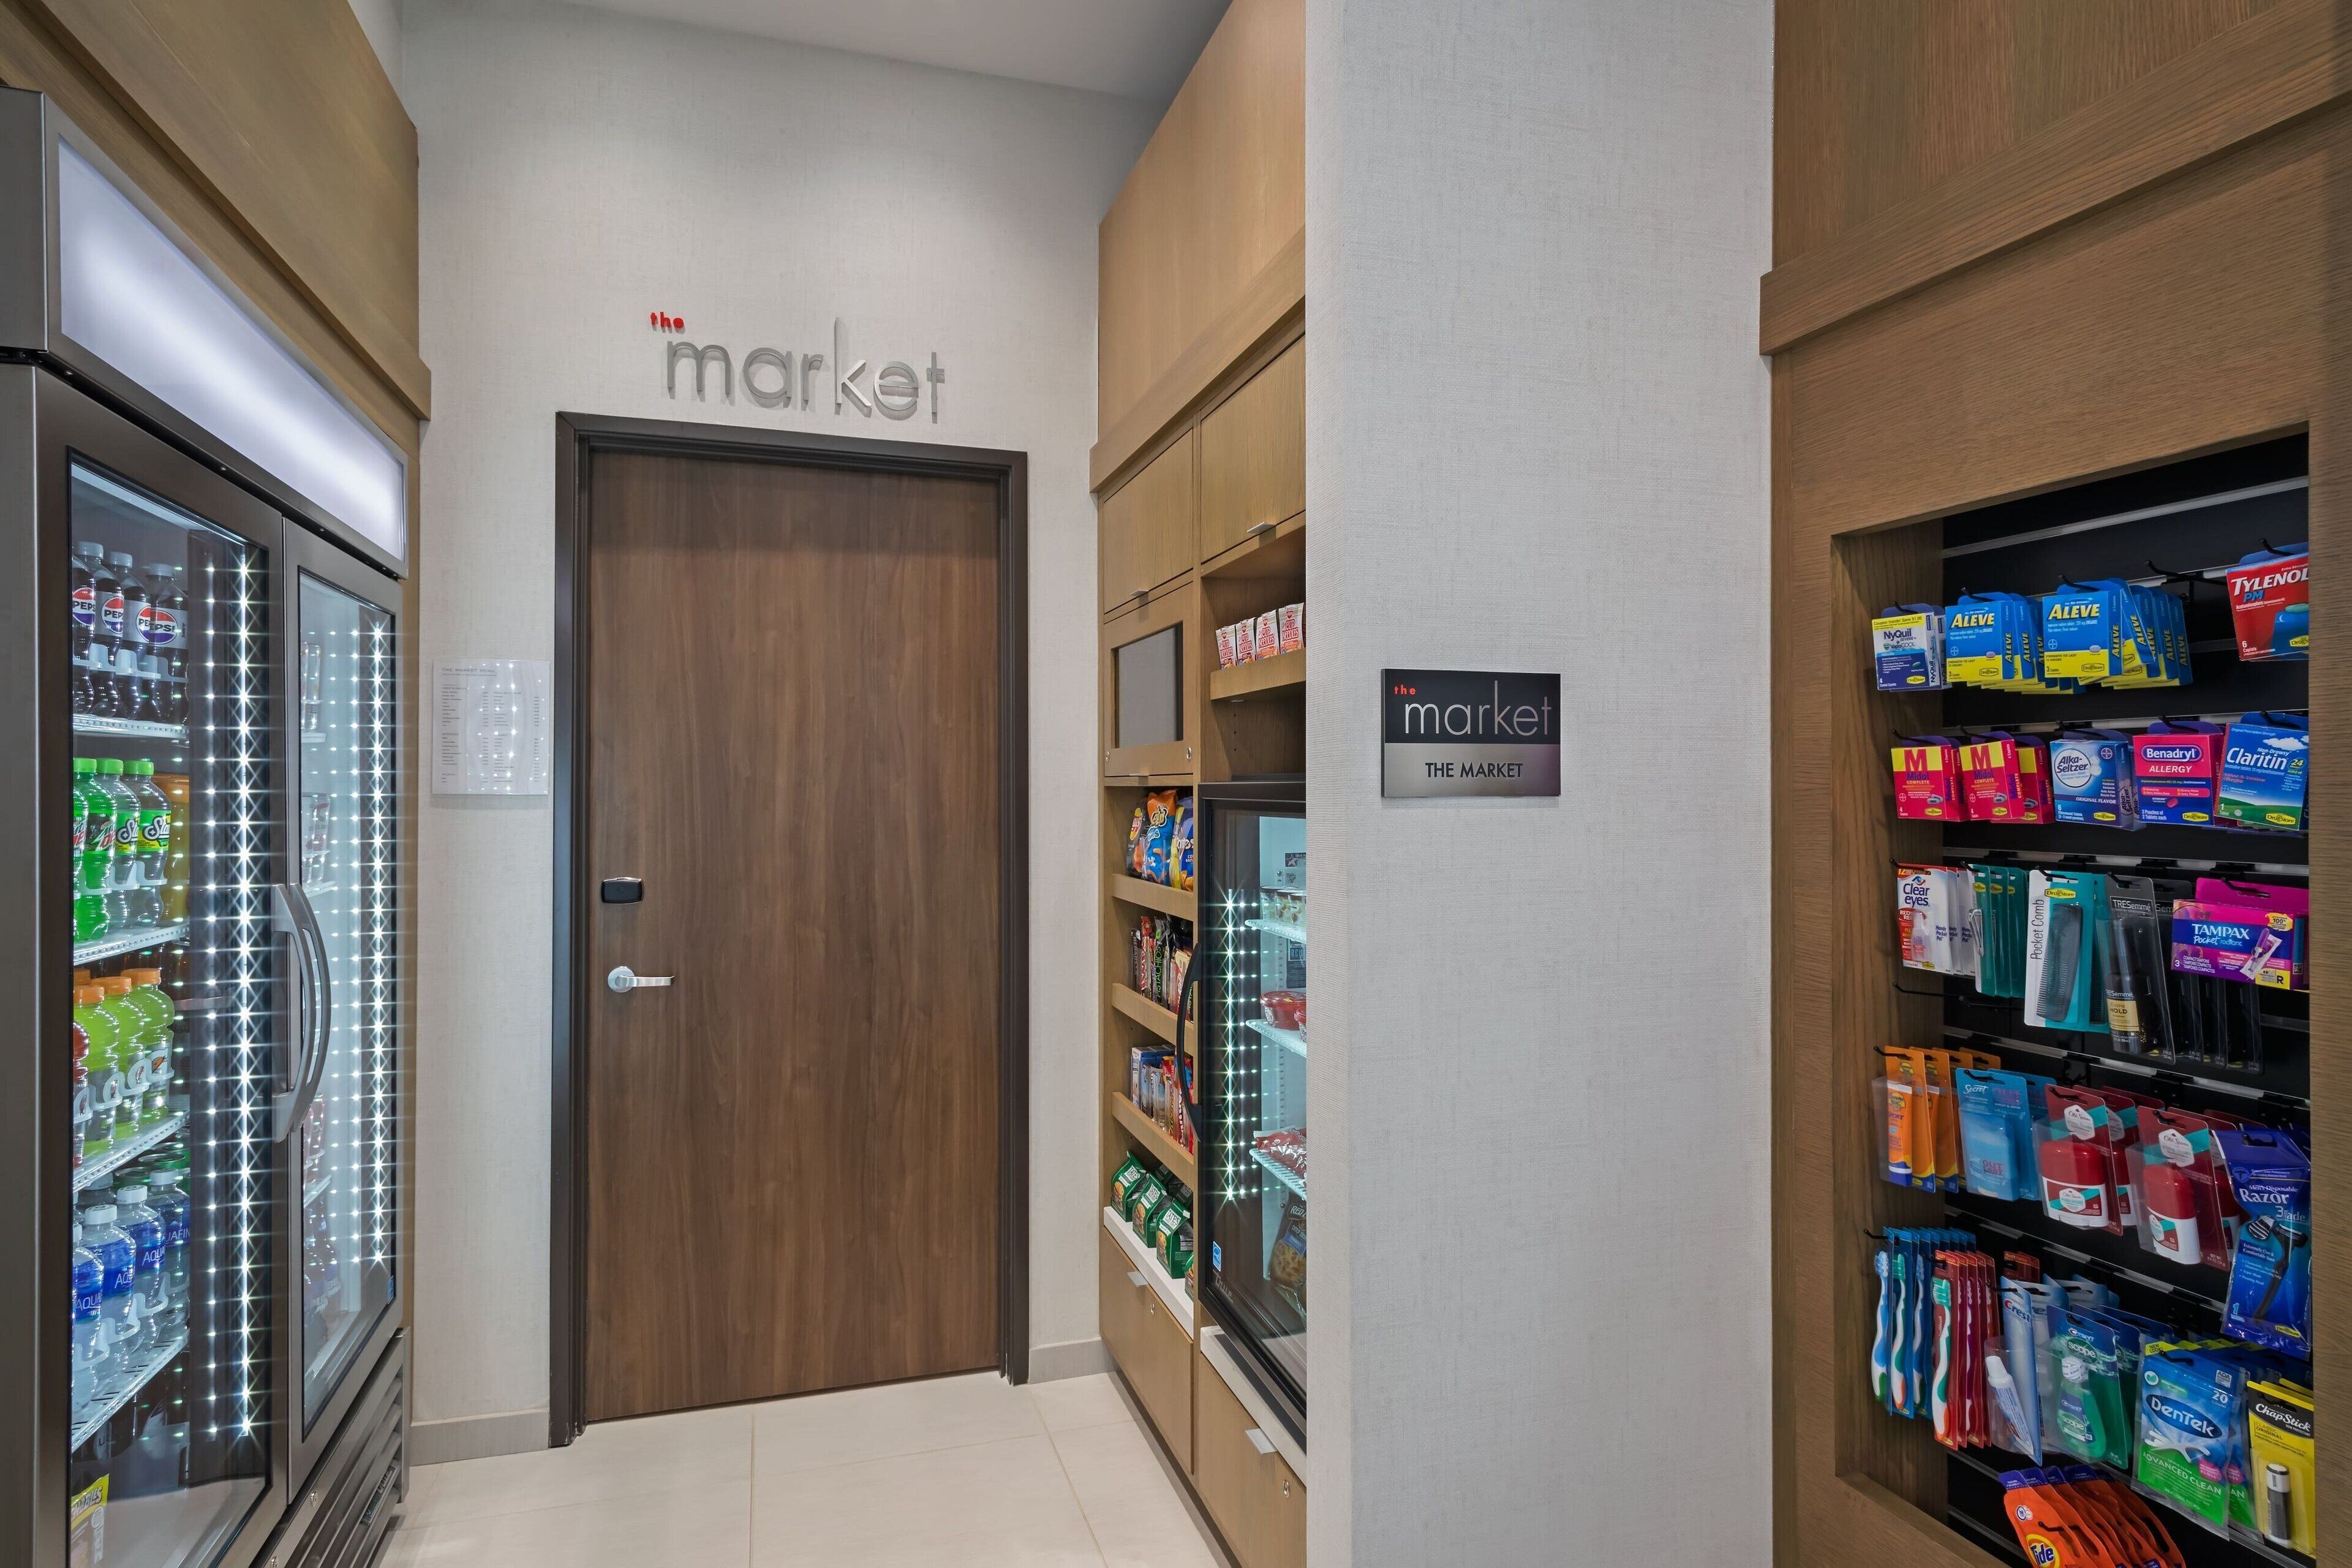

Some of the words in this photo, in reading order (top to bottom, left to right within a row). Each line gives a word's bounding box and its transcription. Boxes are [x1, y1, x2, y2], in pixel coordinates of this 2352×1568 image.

[650, 312, 684, 328] the
[667, 317, 945, 414] market
[2231, 568, 2309, 596] TYLENOL
[2244, 590, 2263, 602] PM
[2048, 603, 2100, 620] ALEVE
[1951, 613, 1995, 629] ALEVE
[1883, 628, 1912, 641] NyQuil
[2130, 615, 2146, 646] ALEVE
[2164, 629, 2174, 661] ALEVE
[2178, 635, 2188, 666] ALEVE
[1394, 684, 1416, 695] the
[1405, 680, 1552, 736] market
[1904, 748, 1928, 771] M
[1970, 745, 1992, 770] M
[2147, 748, 2196, 761] Benadryl
[2226, 747, 2287, 770] Claritin
[2257, 747, 2290, 757] Non-Drowsy
[2058, 756, 2082, 765] Alka-
[1425, 762, 1454, 778] THE
[1460, 762, 1523, 778] MARKET
[1906, 771, 1929, 780] Midol
[2057, 764, 2087, 774] Seltzer
[1903, 883, 1930, 895] Clear
[1904, 895, 1929, 908] eyes
[2113, 899, 2151, 912] TRESemmé
[2032, 899, 2045, 929] Comb
[2192, 924, 2250, 940] TAMPAX
[2030, 930, 2044, 960] Pocket
[2193, 936, 2221, 945] Pocket
[2277, 975, 2284, 985] R
[1963, 1085, 1989, 1095] Secret
[2239, 1188, 2290, 1204] Razor
[2233, 1302, 2239, 1315] 1
[2068, 1341, 2095, 1358] scope
[2212, 1390, 2229, 1404] 20
[2151, 1397, 2215, 1437] DenTek
[2255, 1403, 2311, 1432] ChapStick
[2256, 1426, 2283, 1441] ORIGINAL
[2143, 1452, 2188, 1479] ADVANCED
[2190, 1476, 2222, 1496] CLEAN
[2030, 1543, 2055, 1566] Tide
